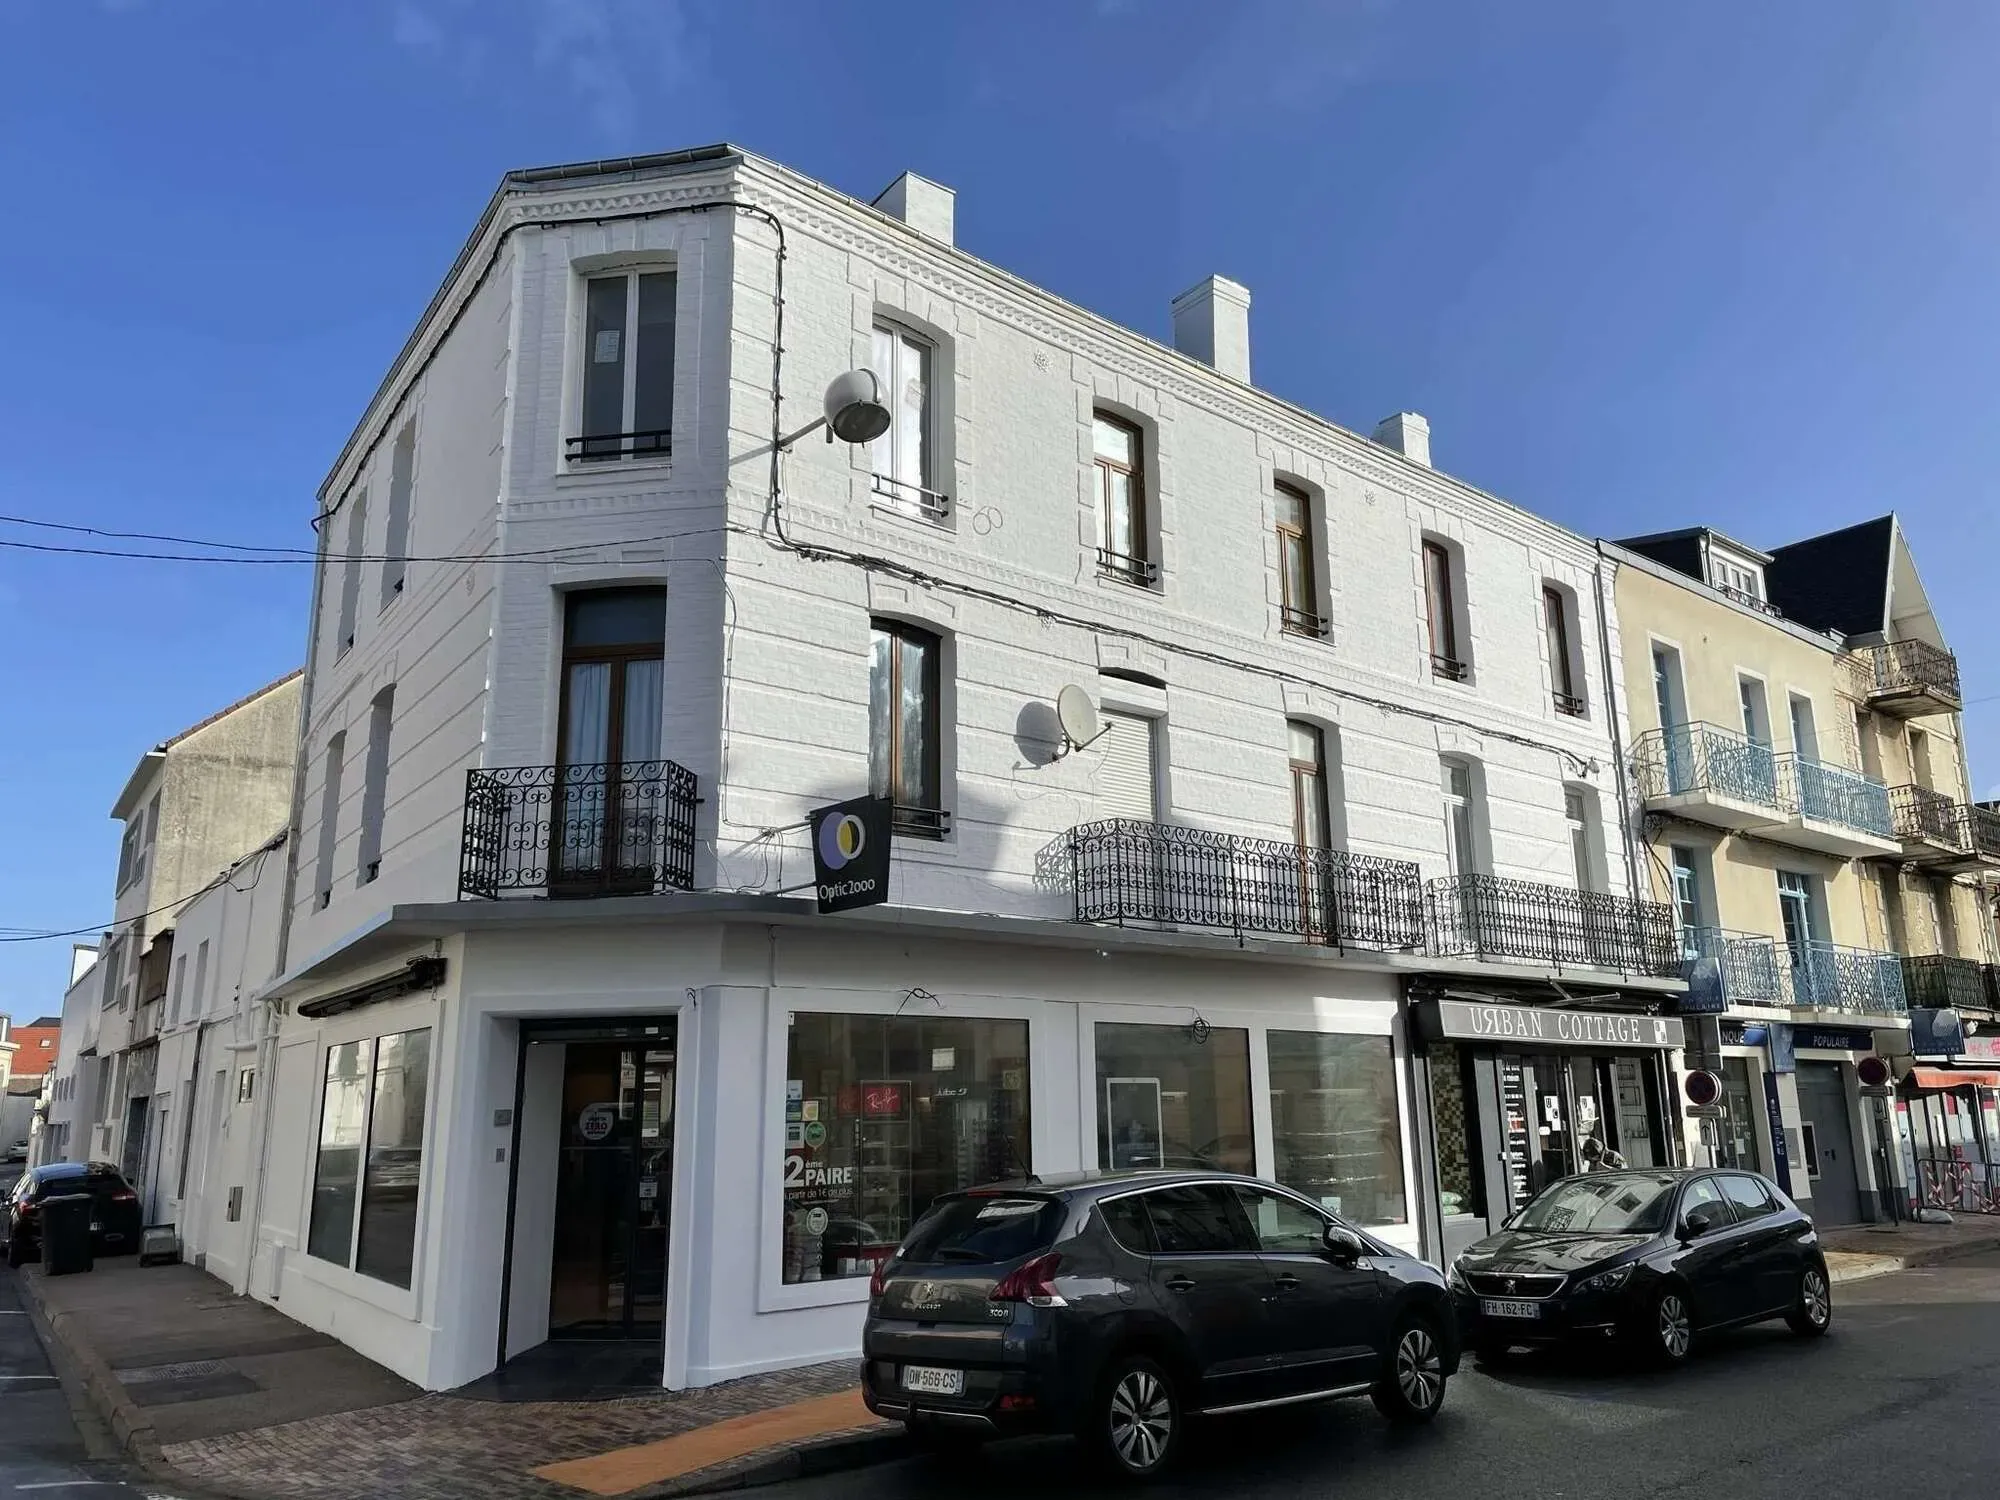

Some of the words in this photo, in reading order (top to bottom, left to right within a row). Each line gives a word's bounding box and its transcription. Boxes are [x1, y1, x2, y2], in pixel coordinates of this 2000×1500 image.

[1558, 1014, 1641, 1042] COTTAGE
[1813, 1035, 1849, 1048] POPULAIRE
[805, 1166, 853, 1187] PAIRE
